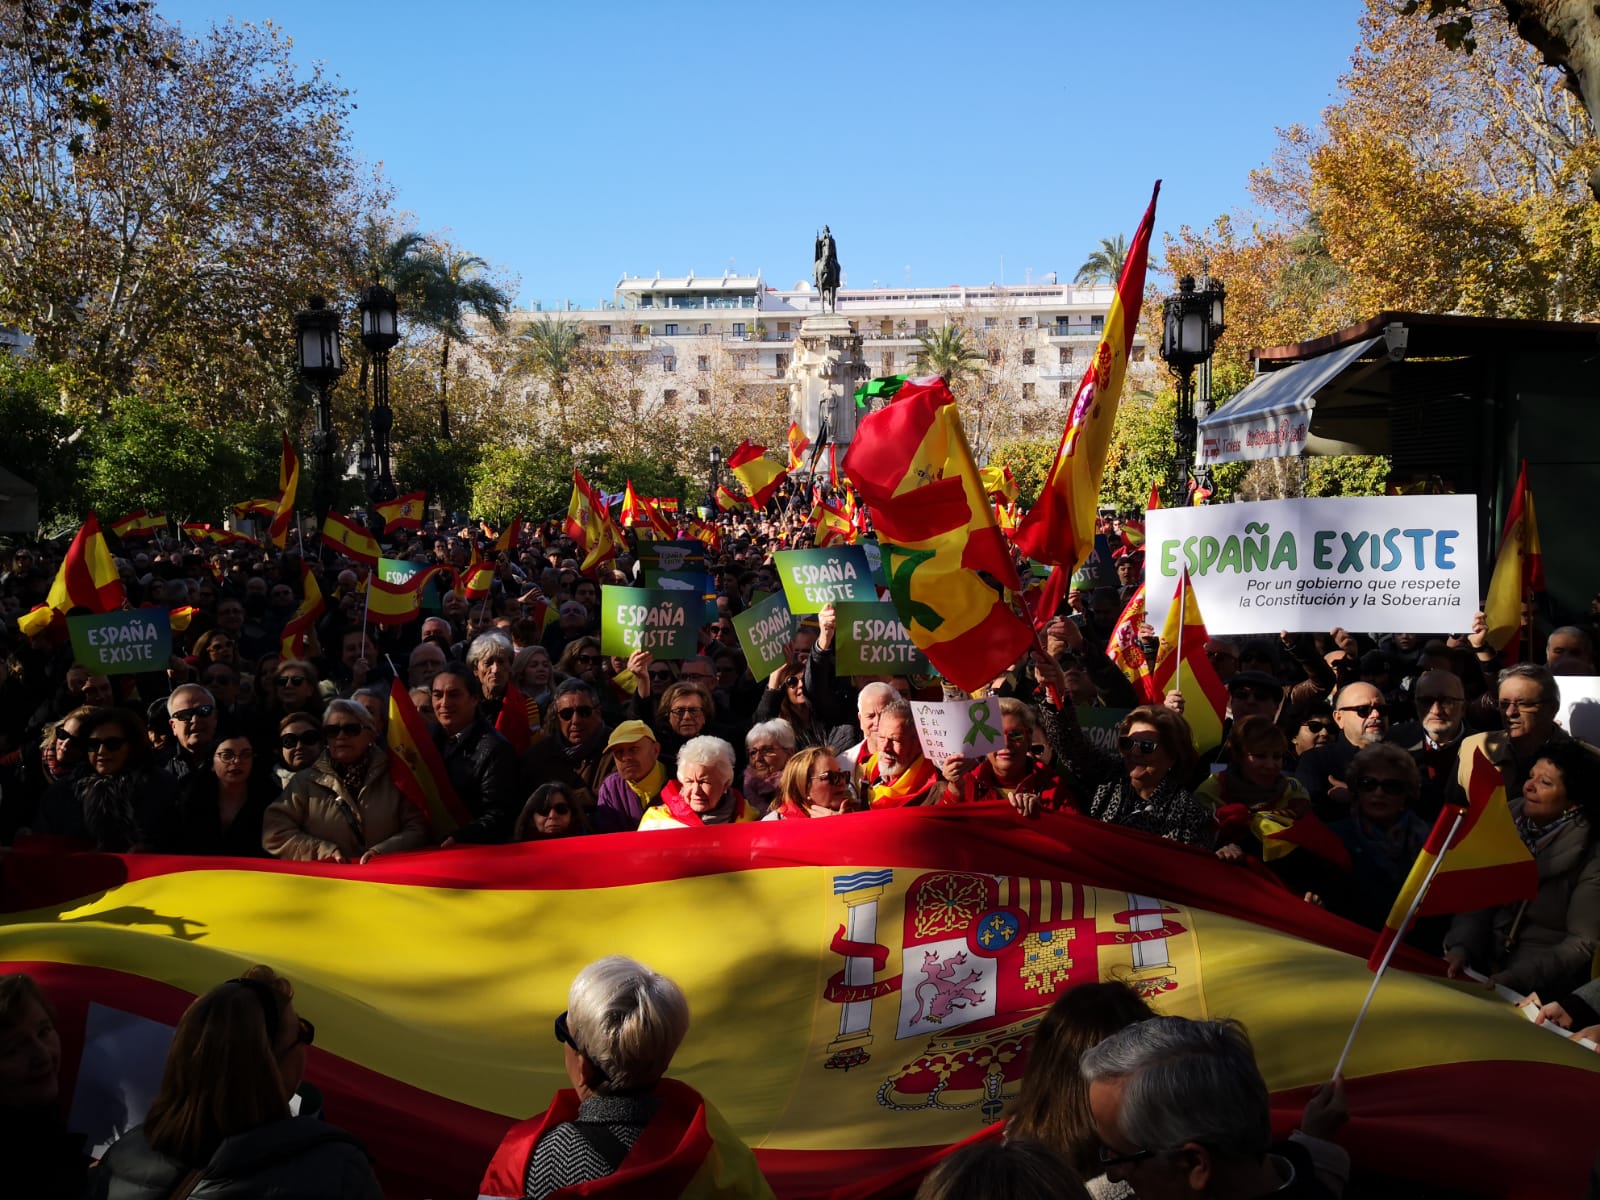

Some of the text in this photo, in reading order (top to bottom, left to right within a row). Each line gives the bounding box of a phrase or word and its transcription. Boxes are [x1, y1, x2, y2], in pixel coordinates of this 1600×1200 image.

[1160, 521, 1460, 577] ESPAÑA EXISTE
[791, 558, 857, 585] ESPAÑA
[1072, 566, 1101, 582] ISTE
[804, 583, 855, 603] EXISTE
[1247, 577, 1461, 592] Por un gobierno que respete
[1239, 596, 1252, 608] la
[1255, 593, 1346, 607] Constitución
[1349, 596, 1360, 609] y
[1363, 593, 1377, 607] la
[616, 602, 685, 627] ESPAÑA
[87, 619, 158, 647] ESPAÑA
[748, 605, 792, 646] ESPAÑA
[623, 629, 676, 648] EXISTE
[98, 643, 154, 664] EXISTE
[859, 644, 917, 663] EXISTE
[1114, 926, 1173, 944] PLVS
